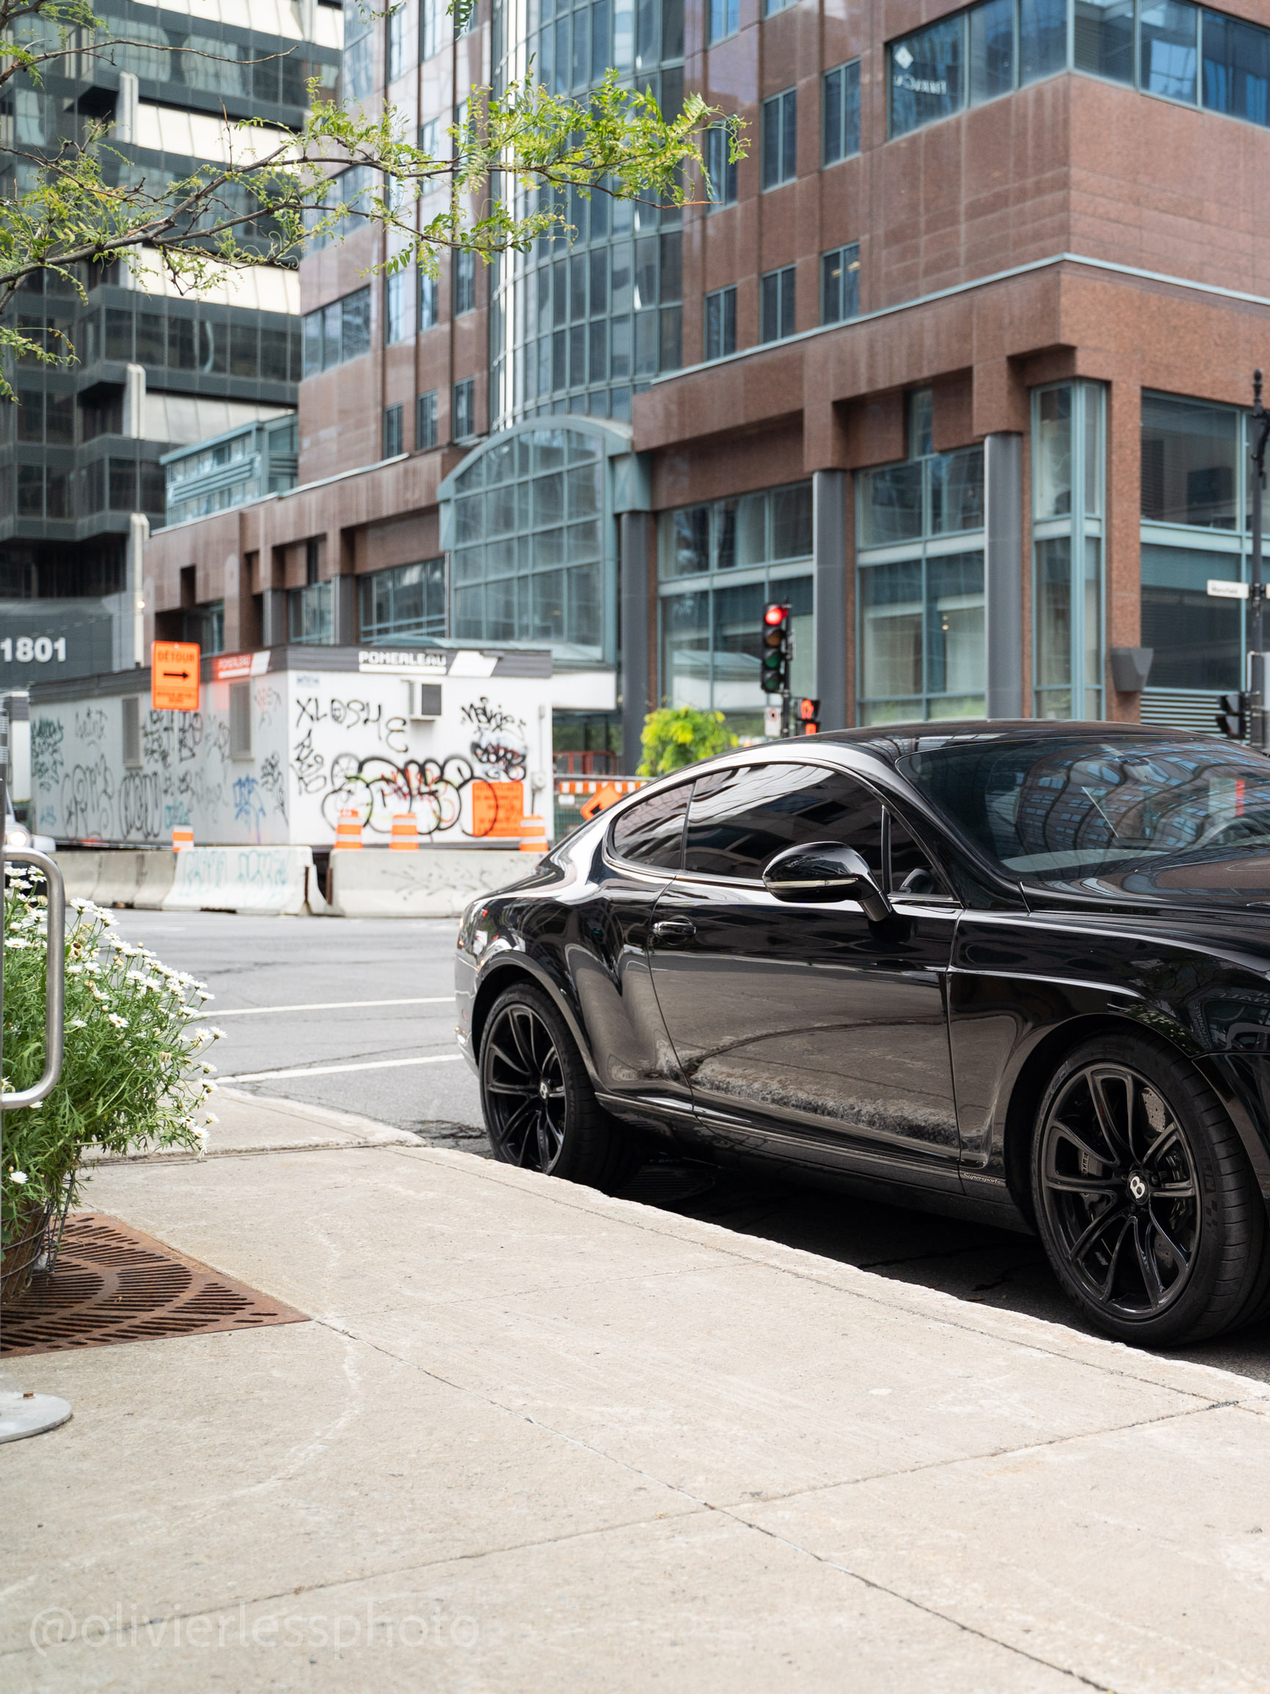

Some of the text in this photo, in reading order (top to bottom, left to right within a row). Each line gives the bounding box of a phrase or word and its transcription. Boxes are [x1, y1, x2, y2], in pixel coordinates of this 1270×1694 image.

[0, 636, 67, 663] 1801
[157, 649, 195, 664] DÉTOUR
[358, 650, 447, 666] POMERLEAU
[1130, 1175, 1146, 1199] B
